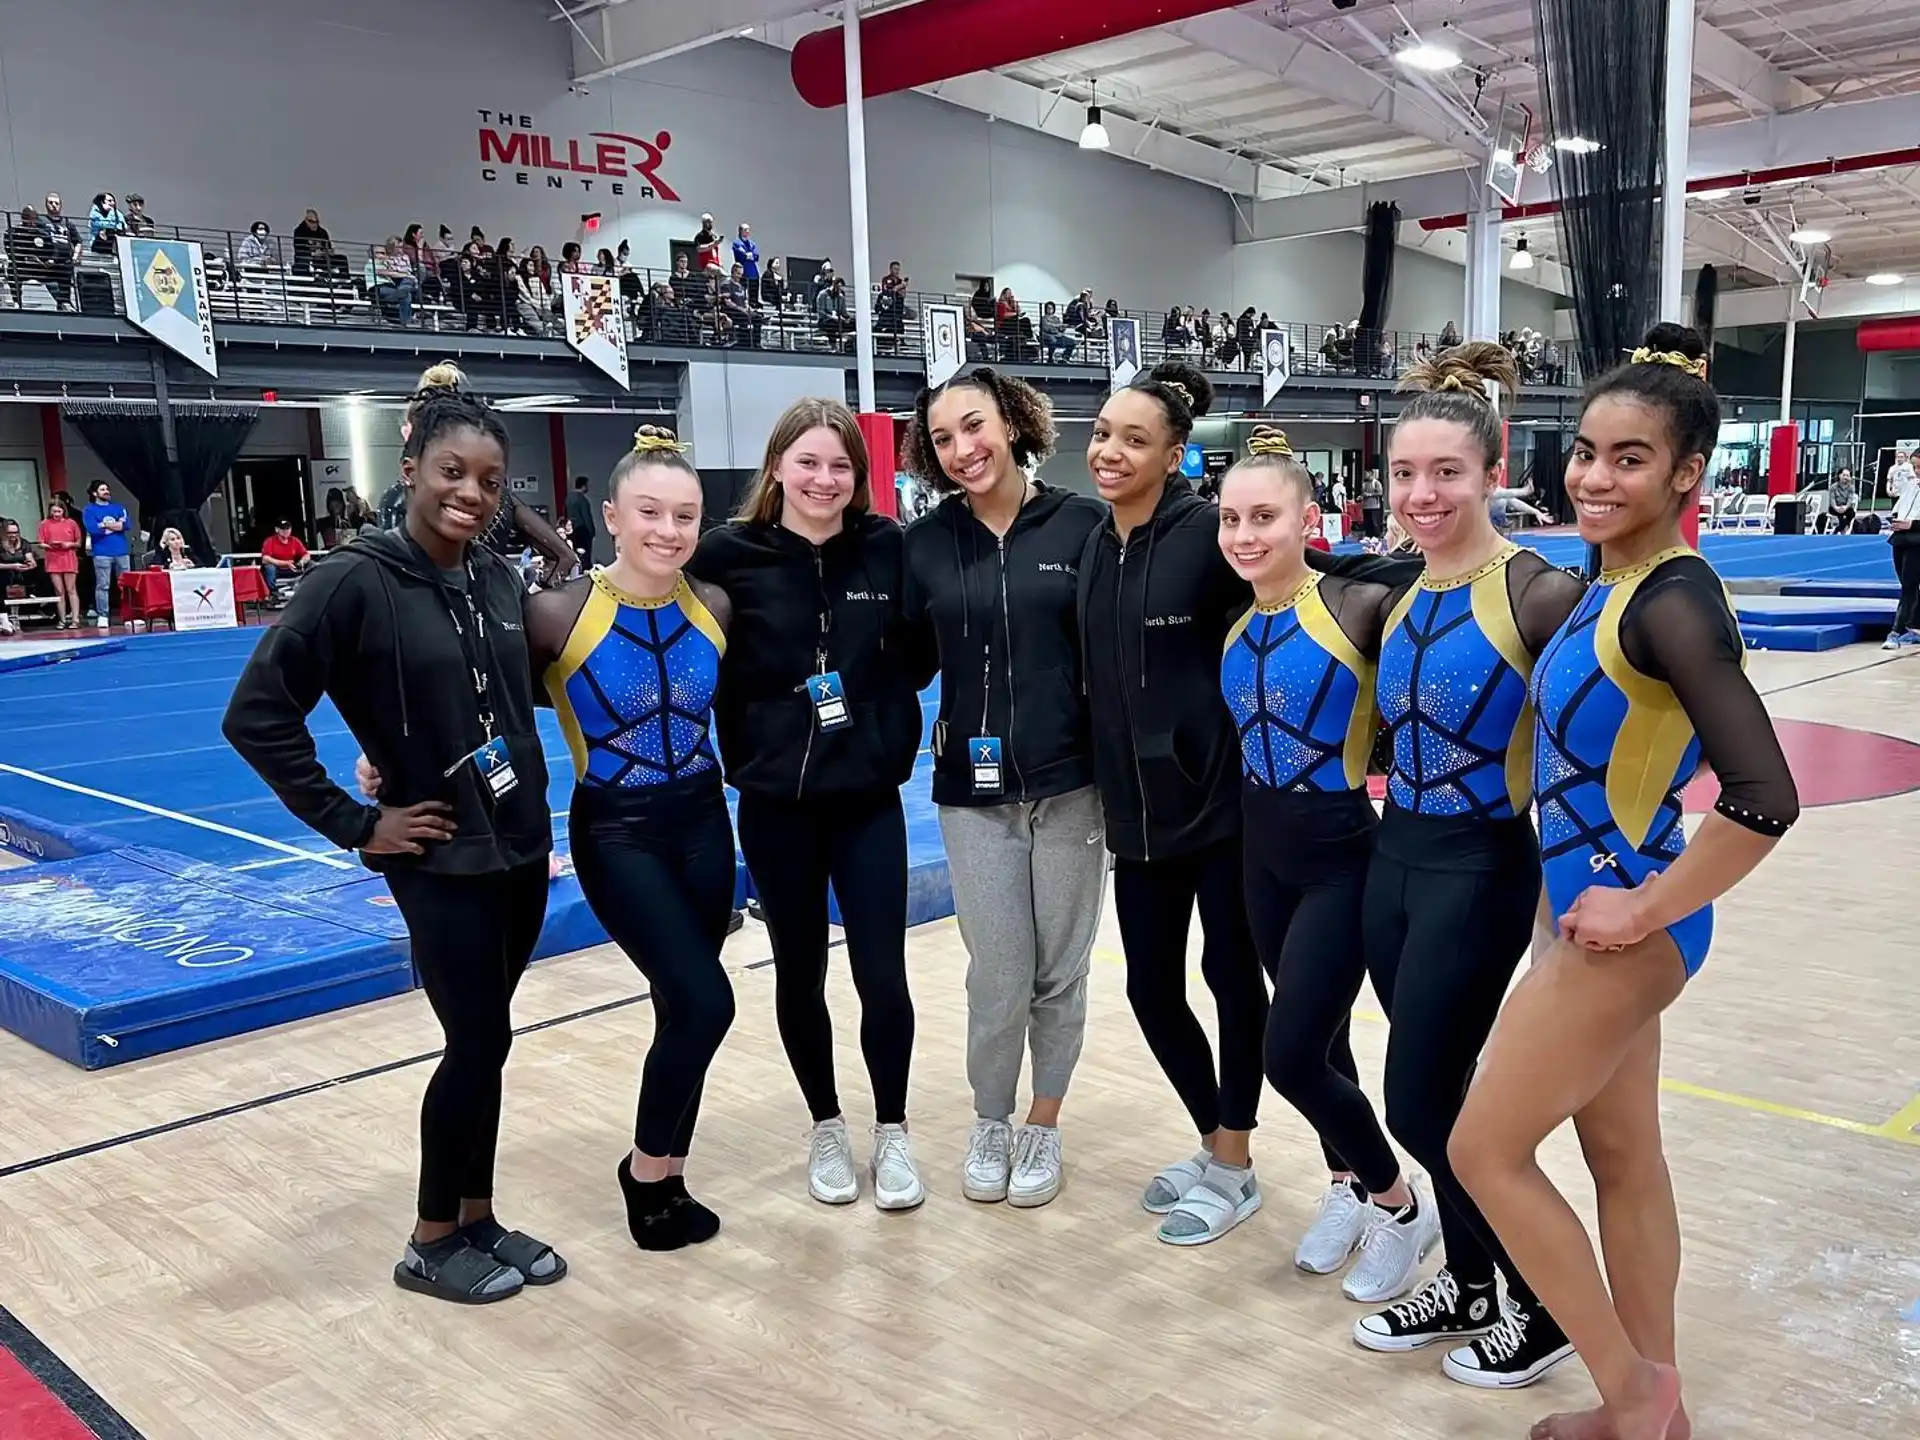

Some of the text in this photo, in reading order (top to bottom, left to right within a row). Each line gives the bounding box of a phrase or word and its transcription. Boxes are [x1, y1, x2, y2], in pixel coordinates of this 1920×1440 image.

[478, 109, 532, 128] THE
[479, 129, 681, 202] MILLER
[482, 168, 655, 199] CENTER
[193, 267, 212, 356] DELAWARE
